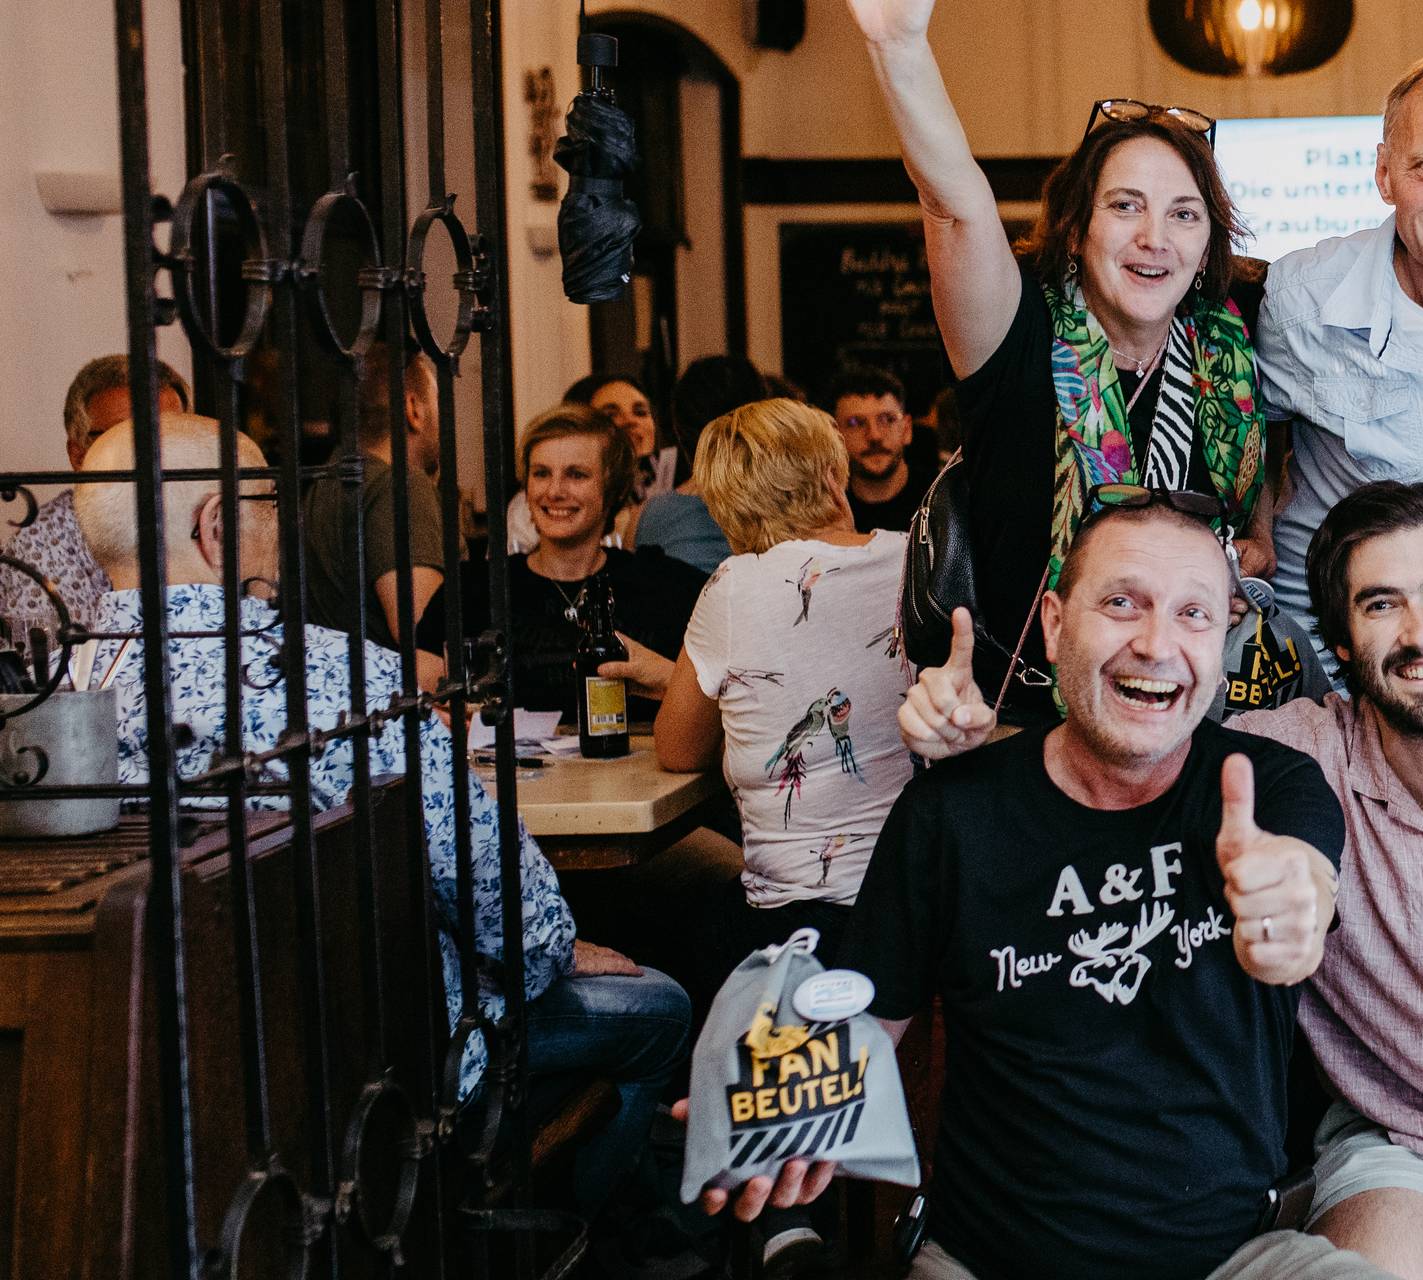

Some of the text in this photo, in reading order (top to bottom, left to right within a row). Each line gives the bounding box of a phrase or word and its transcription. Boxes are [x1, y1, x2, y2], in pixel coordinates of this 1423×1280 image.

[1046, 842, 1182, 916] A & F
[990, 906, 1231, 992] New York
[731, 1045, 869, 1122] BEUTEL!
[752, 1031, 840, 1087] FAN
